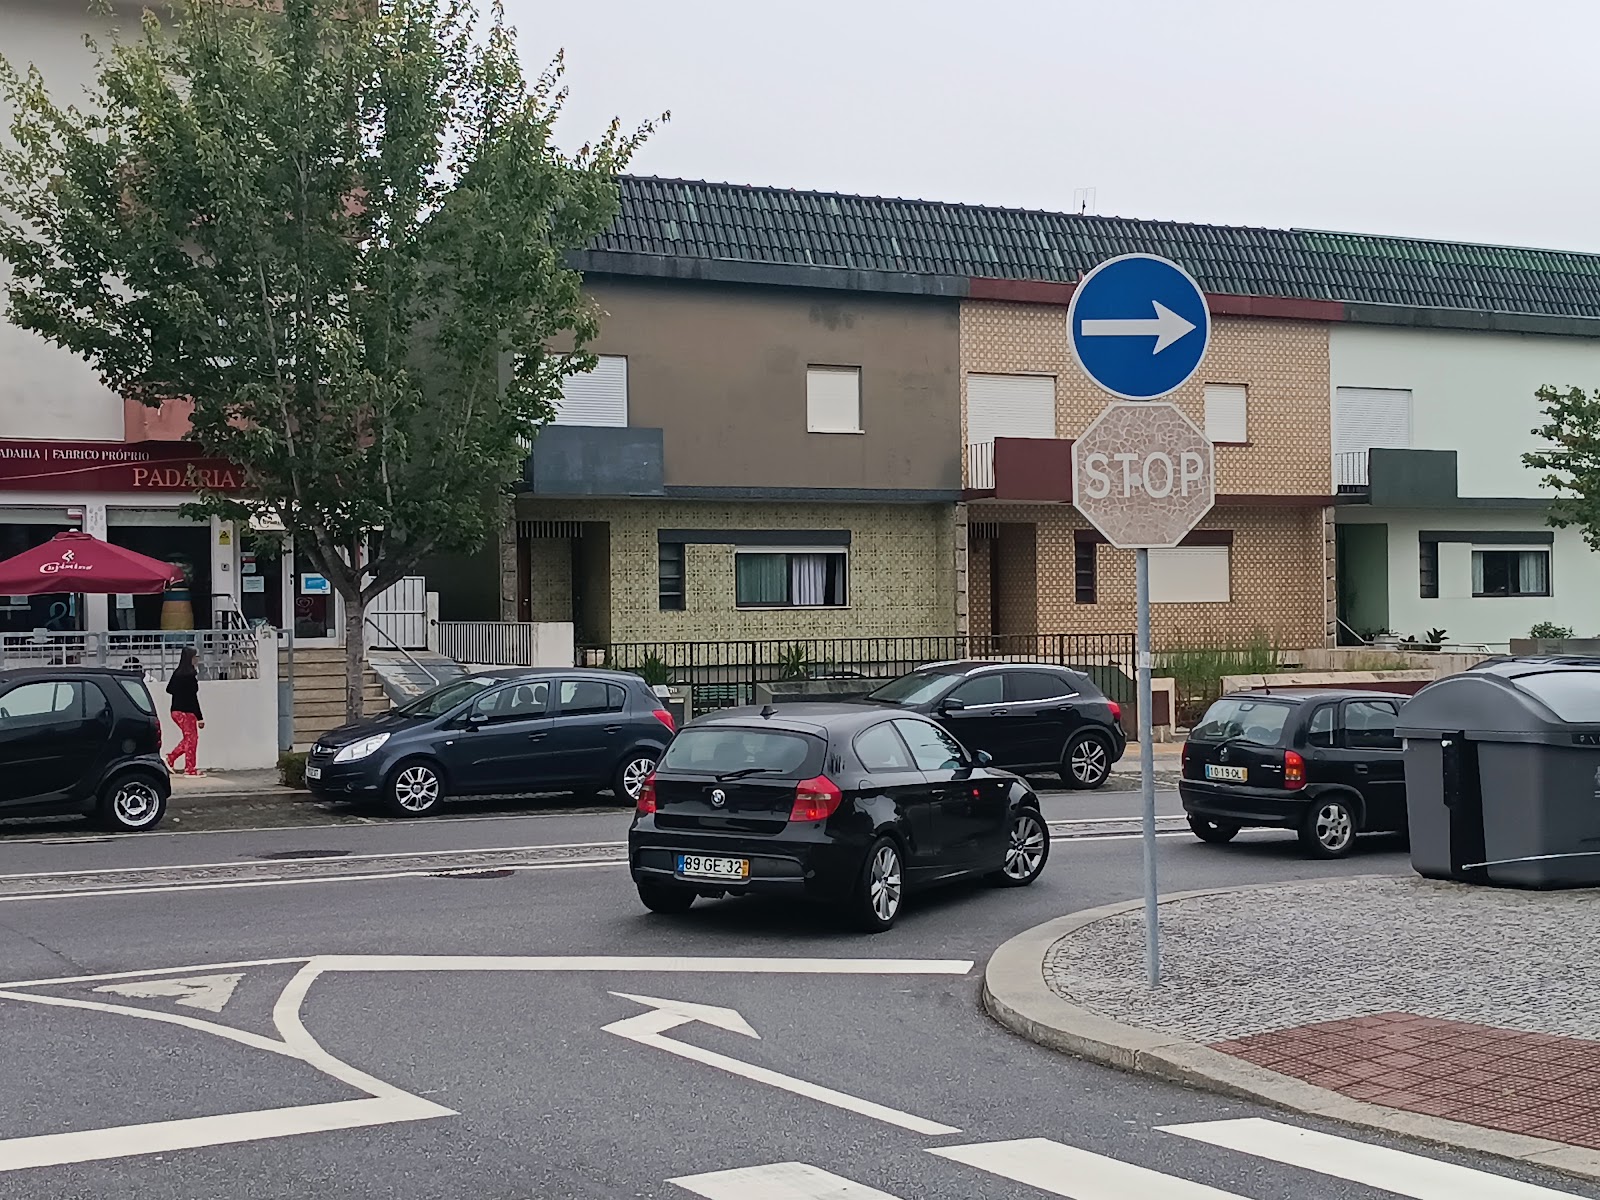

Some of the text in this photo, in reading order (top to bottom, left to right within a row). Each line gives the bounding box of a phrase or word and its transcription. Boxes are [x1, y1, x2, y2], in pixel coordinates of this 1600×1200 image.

[52, 449, 100, 460] FABRICO
[101, 449, 150, 461] PRÓPRIO
[132, 467, 237, 488] PADARIA
[1084, 451, 1204, 499] STOP
